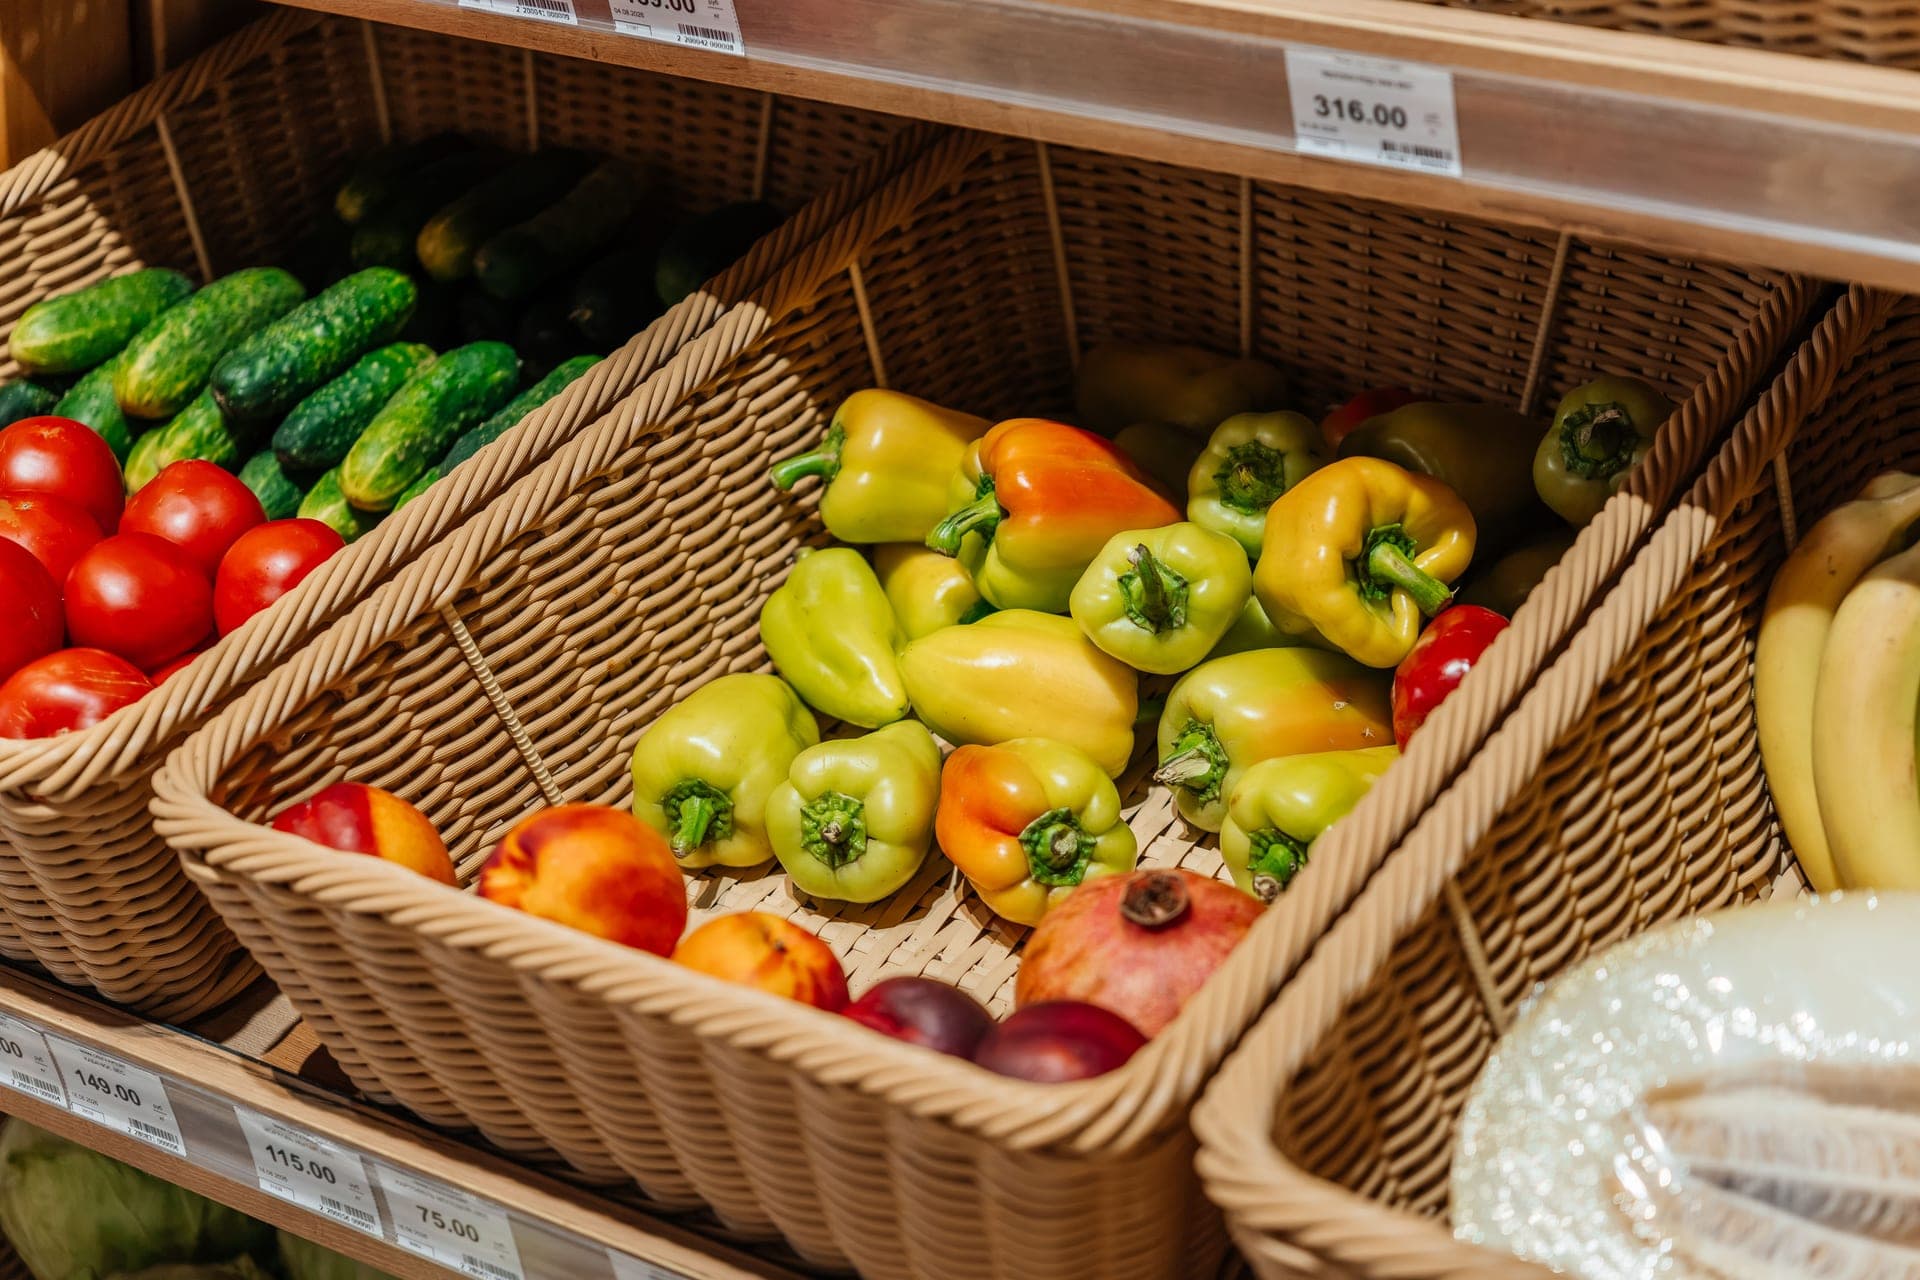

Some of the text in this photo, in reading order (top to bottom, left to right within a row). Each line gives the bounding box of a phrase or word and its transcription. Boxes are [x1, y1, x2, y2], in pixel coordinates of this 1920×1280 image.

[1314, 94, 1407, 129] 316.00
[75, 1070, 141, 1106] 149.00
[266, 1144, 336, 1184] 115.00
[416, 1205, 479, 1242] 75.00
